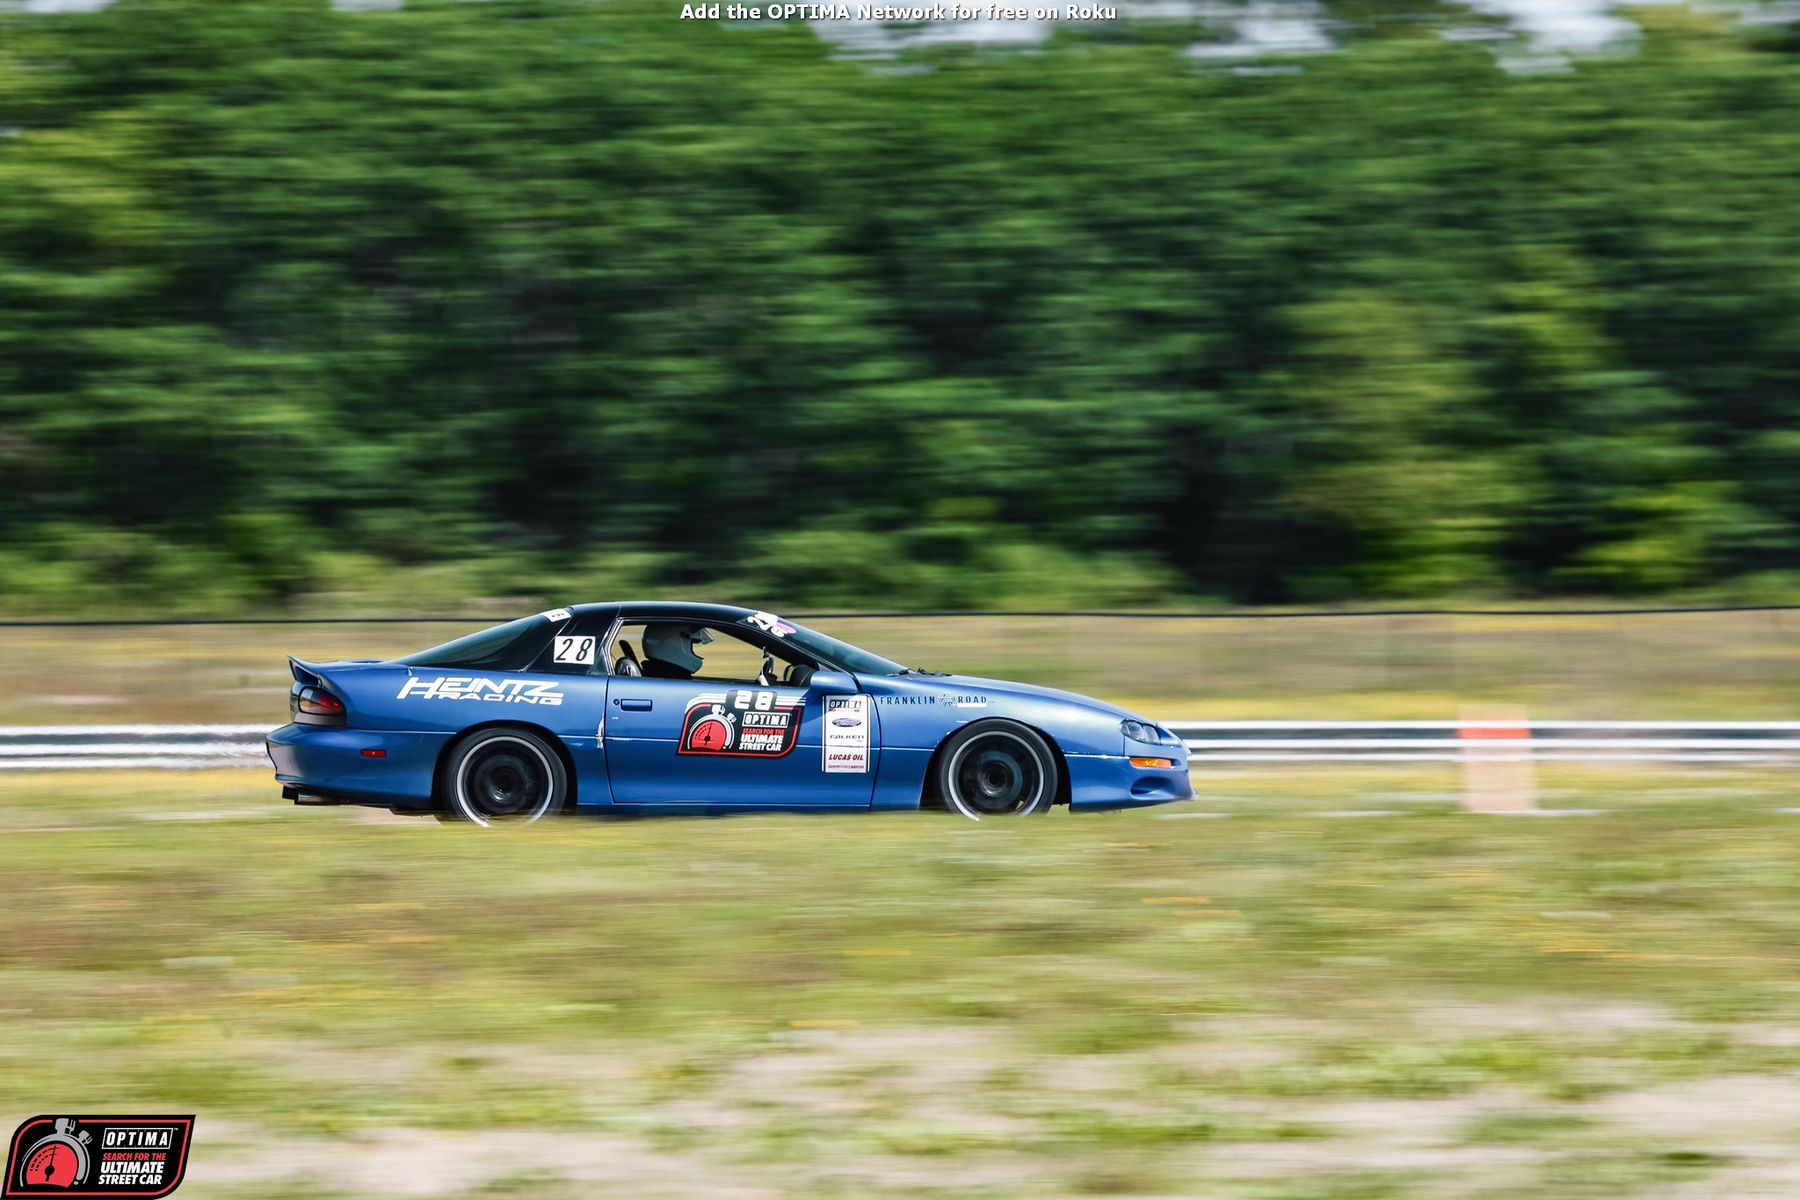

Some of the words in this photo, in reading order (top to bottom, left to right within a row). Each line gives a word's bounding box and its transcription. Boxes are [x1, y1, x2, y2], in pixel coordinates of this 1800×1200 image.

[555, 638, 593, 662] 28
[397, 677, 564, 700] HEINTZ
[438, 692, 564, 706] RACING
[734, 690, 774, 710] 28
[880, 695, 935, 705] FRANKLIN
[958, 695, 987, 703] ROAD
[744, 713, 787, 726] OPTIMA
[740, 733, 784, 744] ULTIMATE
[739, 742, 766, 750] STREET
[766, 743, 782, 751] CAR
